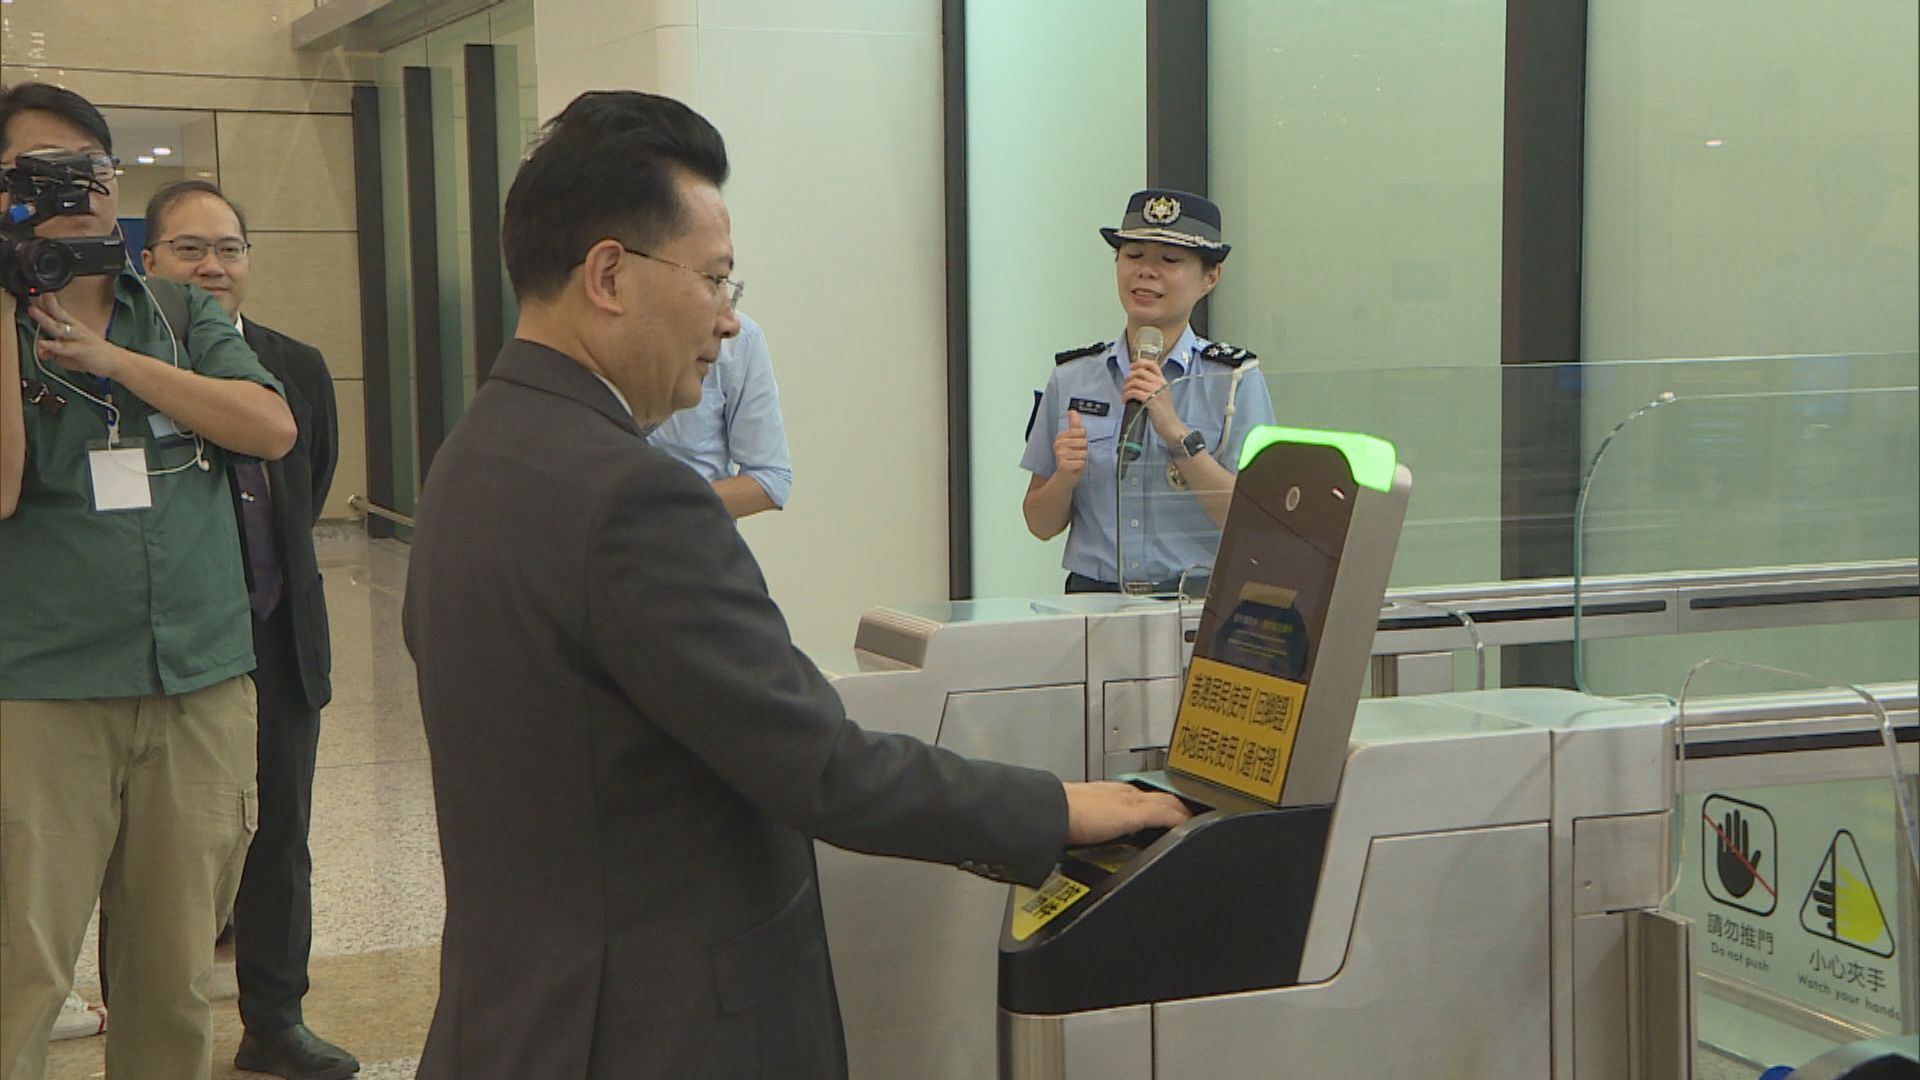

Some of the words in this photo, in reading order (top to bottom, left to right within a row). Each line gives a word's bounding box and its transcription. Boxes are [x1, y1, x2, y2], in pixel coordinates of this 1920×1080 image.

[1707, 912, 1774, 955] 請勿推門
[1711, 941, 1725, 957] Do
[1727, 950, 1743, 962] not
[1745, 957, 1769, 972] push
[1809, 948, 1886, 992] 小心夾手
[1798, 973, 1831, 995] Watch
[1835, 990, 1860, 1006] your
